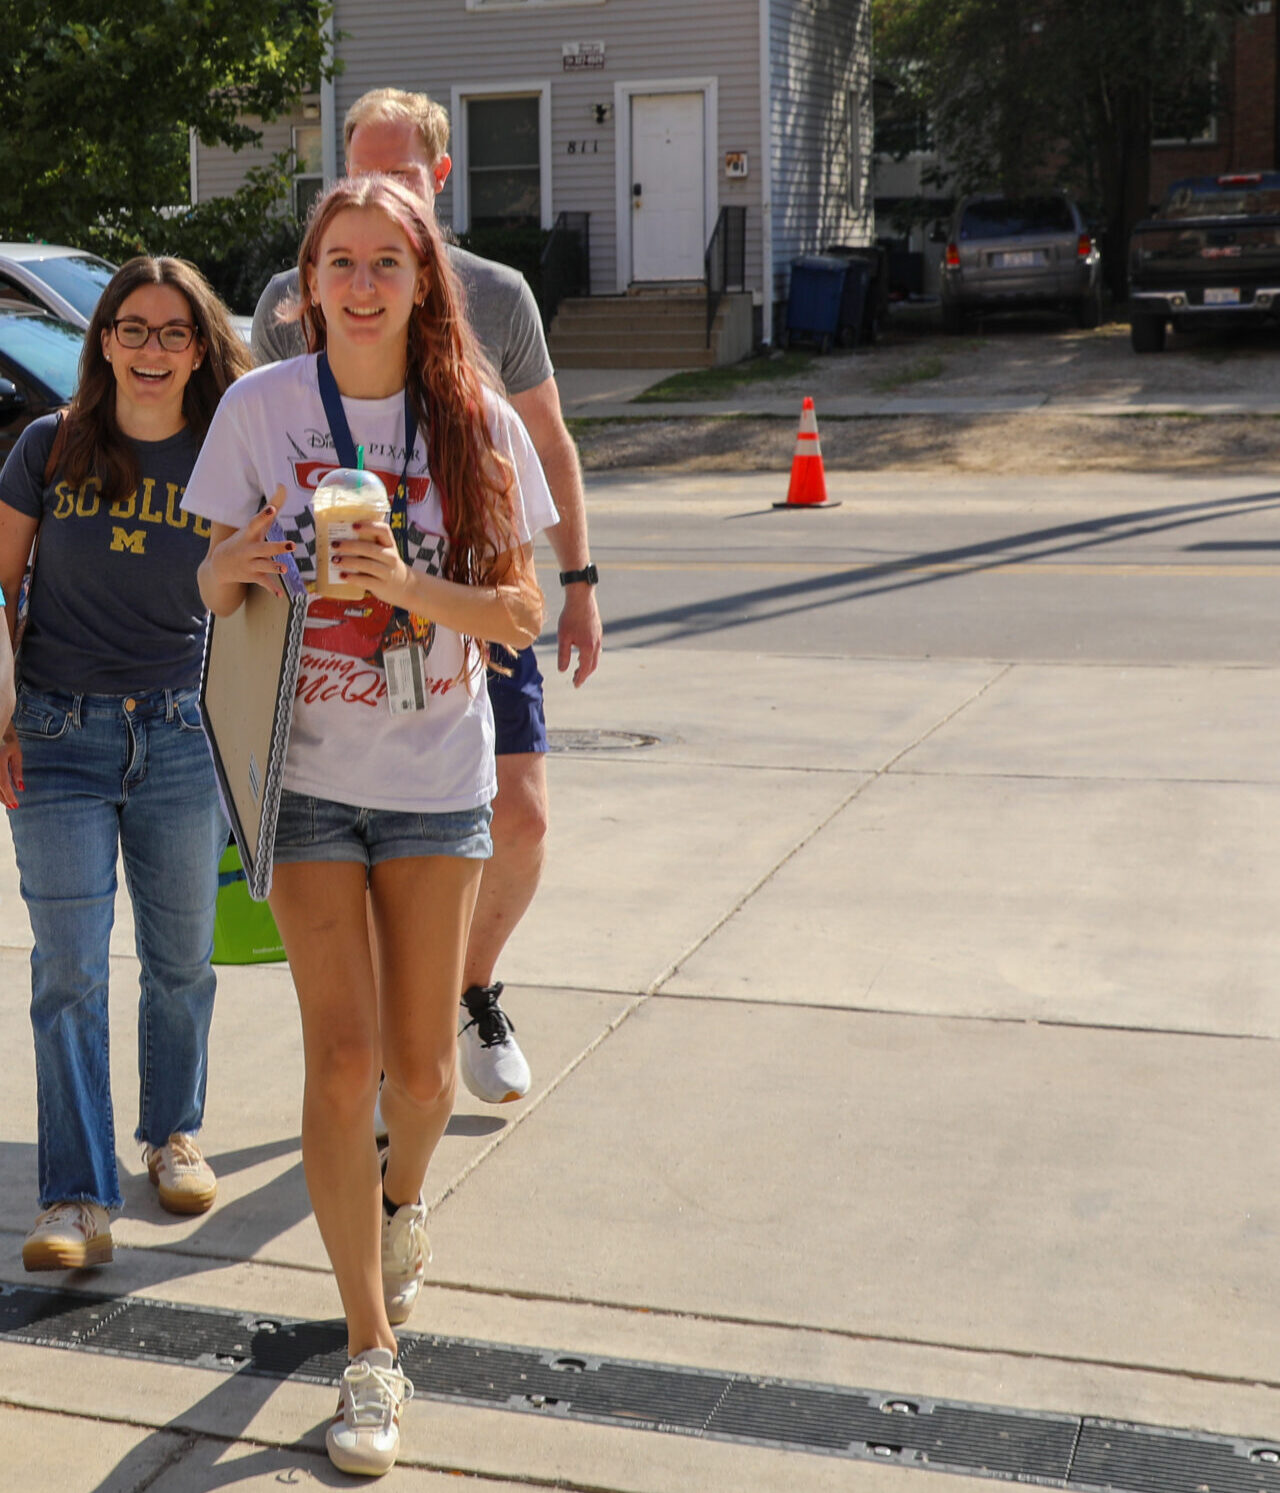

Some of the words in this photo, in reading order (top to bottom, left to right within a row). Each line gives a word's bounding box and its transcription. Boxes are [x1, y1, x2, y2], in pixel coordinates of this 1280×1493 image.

[567, 140, 598, 154] 811
[369, 443, 421, 462] PIXAR
[110, 526, 147, 554] M
[299, 653, 356, 678] tning
[296, 670, 455, 707] McQun
